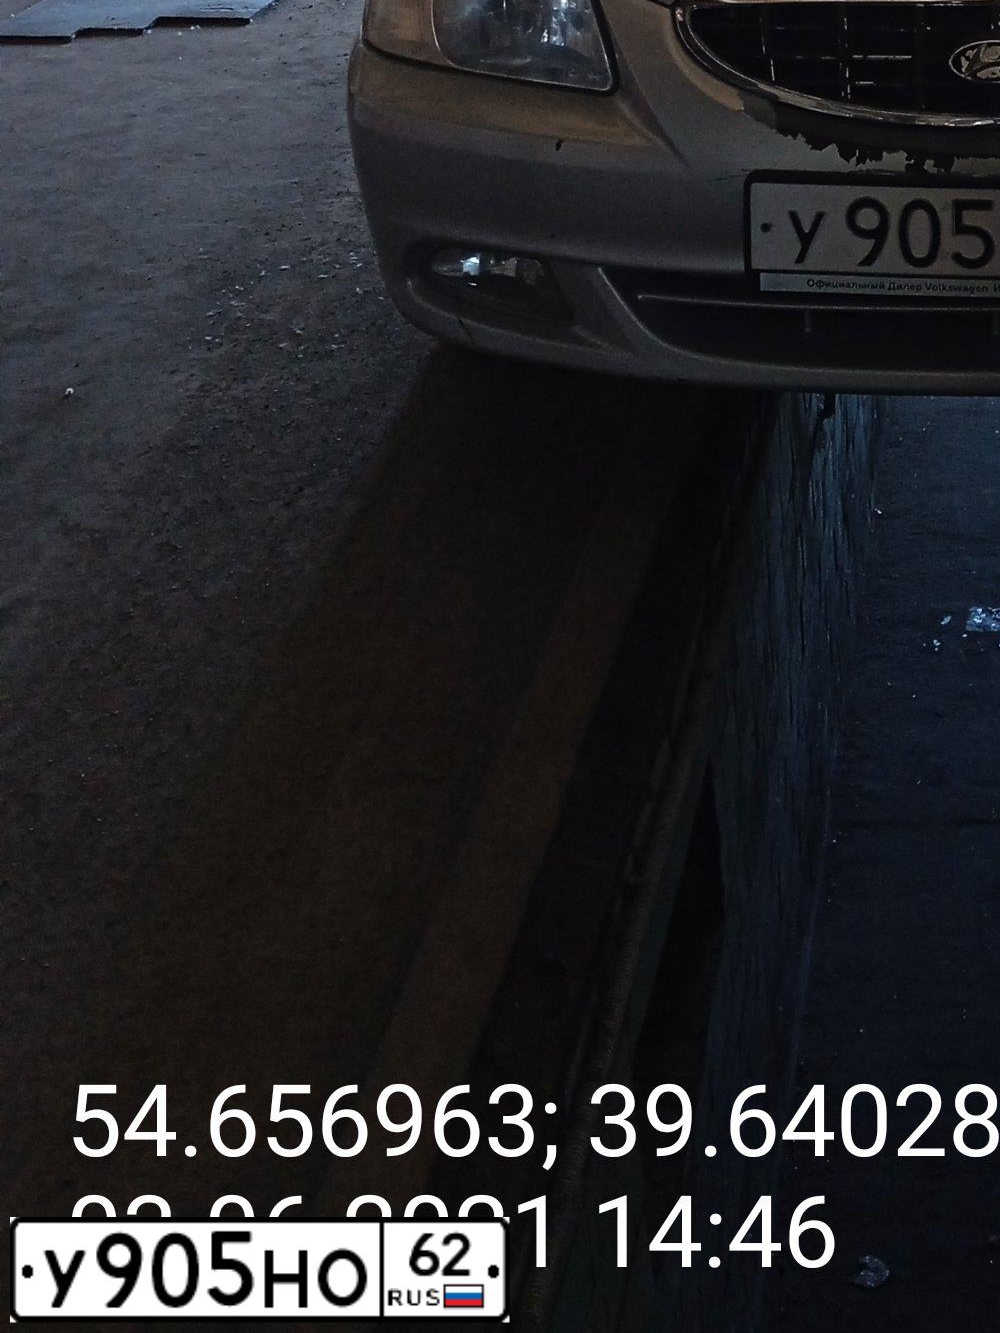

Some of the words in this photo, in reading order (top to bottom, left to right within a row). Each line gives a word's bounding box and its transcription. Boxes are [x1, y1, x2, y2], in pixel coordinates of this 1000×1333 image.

[806, 278, 884, 290] Официальный
[887, 281, 921, 292] Дилер
[924, 282, 988, 294] Volkswagen
